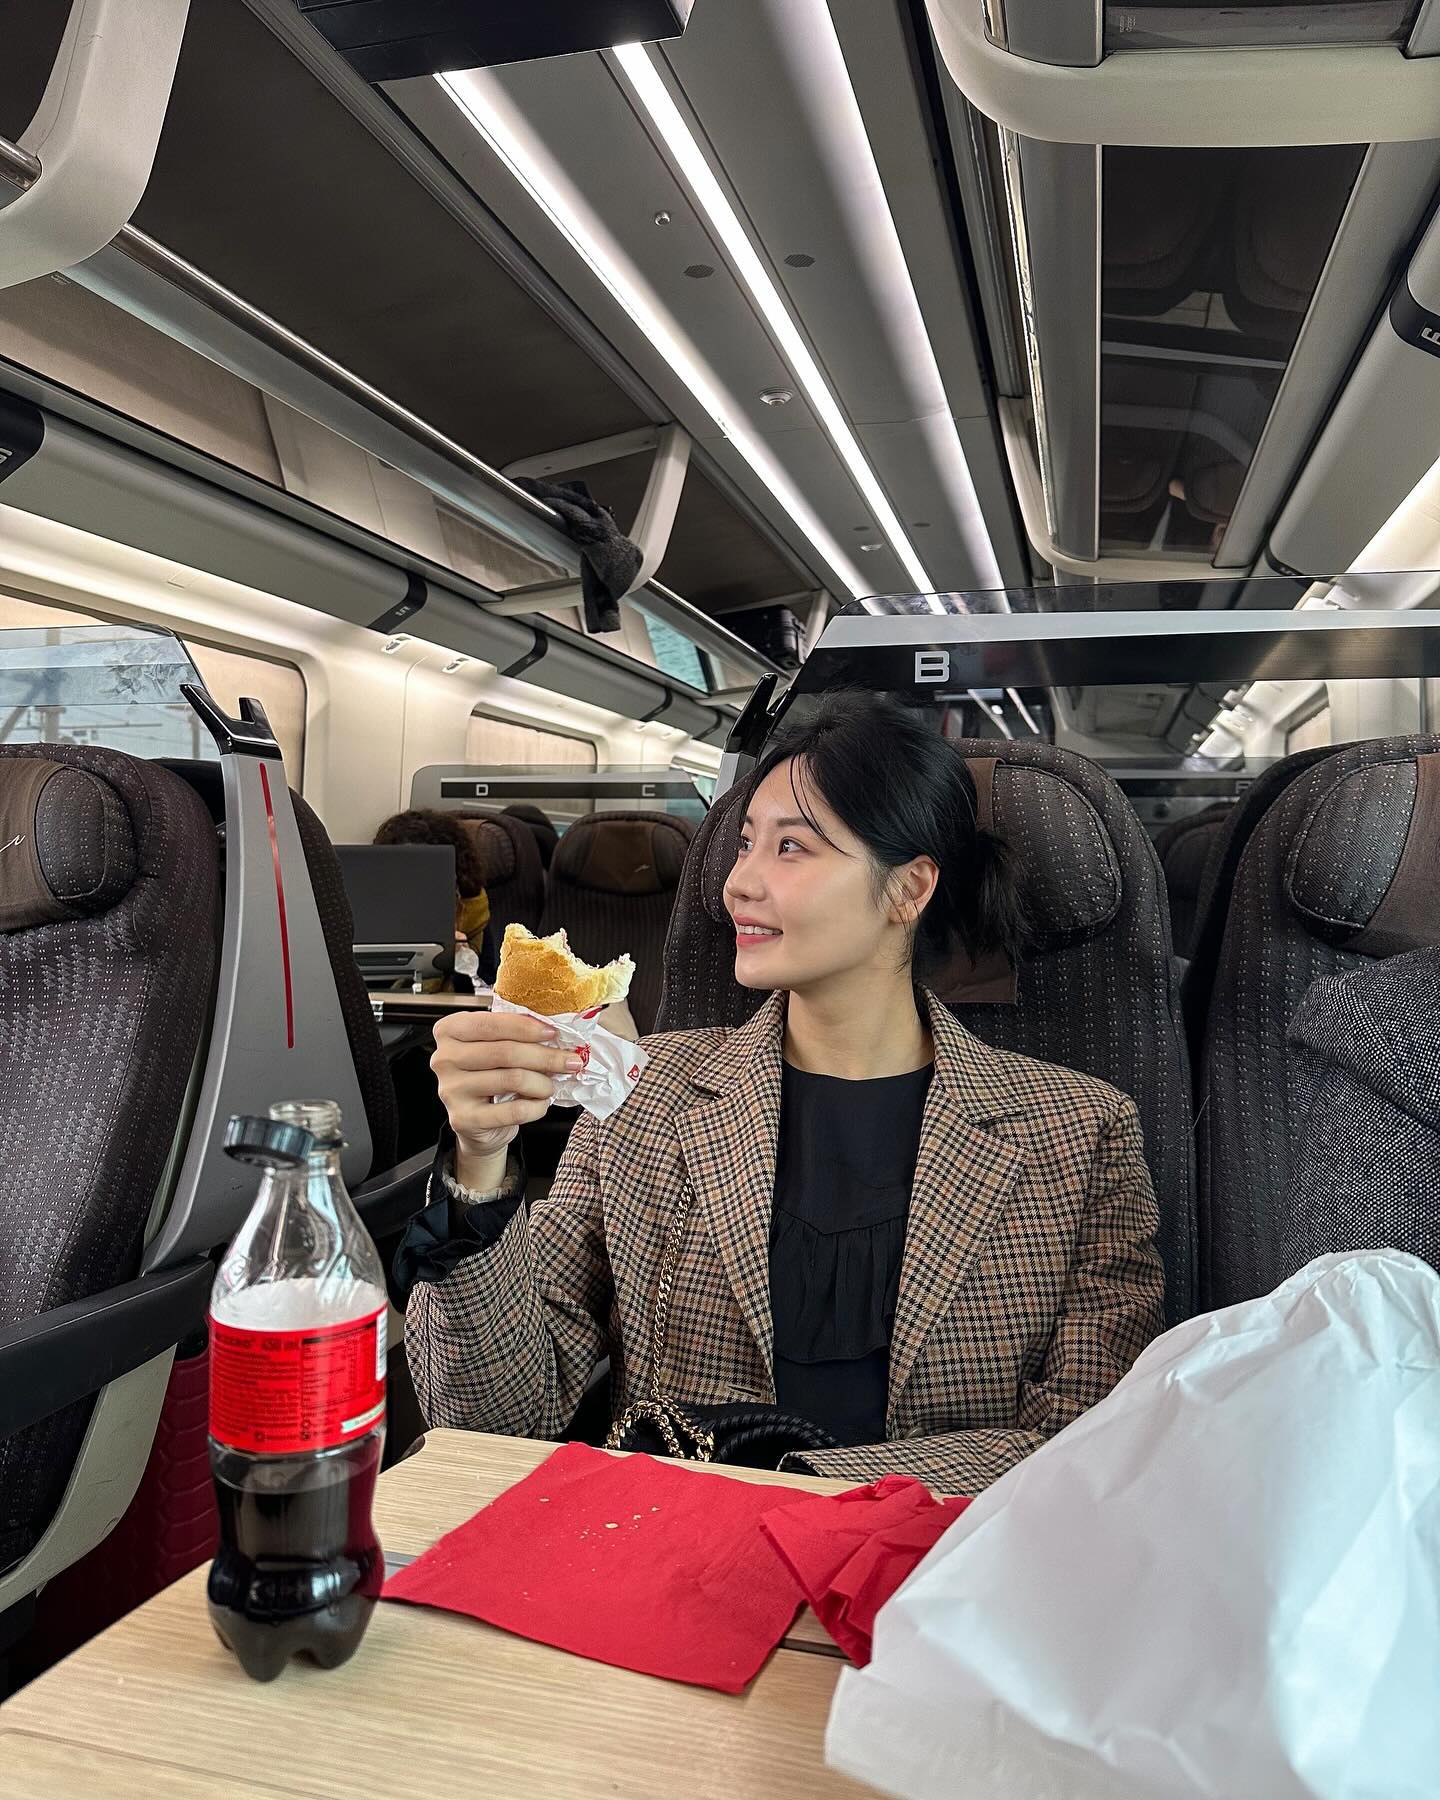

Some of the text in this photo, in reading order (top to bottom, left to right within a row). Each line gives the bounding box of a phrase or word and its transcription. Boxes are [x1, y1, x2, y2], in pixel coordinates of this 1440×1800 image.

[914, 650, 949, 683] B
[476, 784, 656, 797] D C
